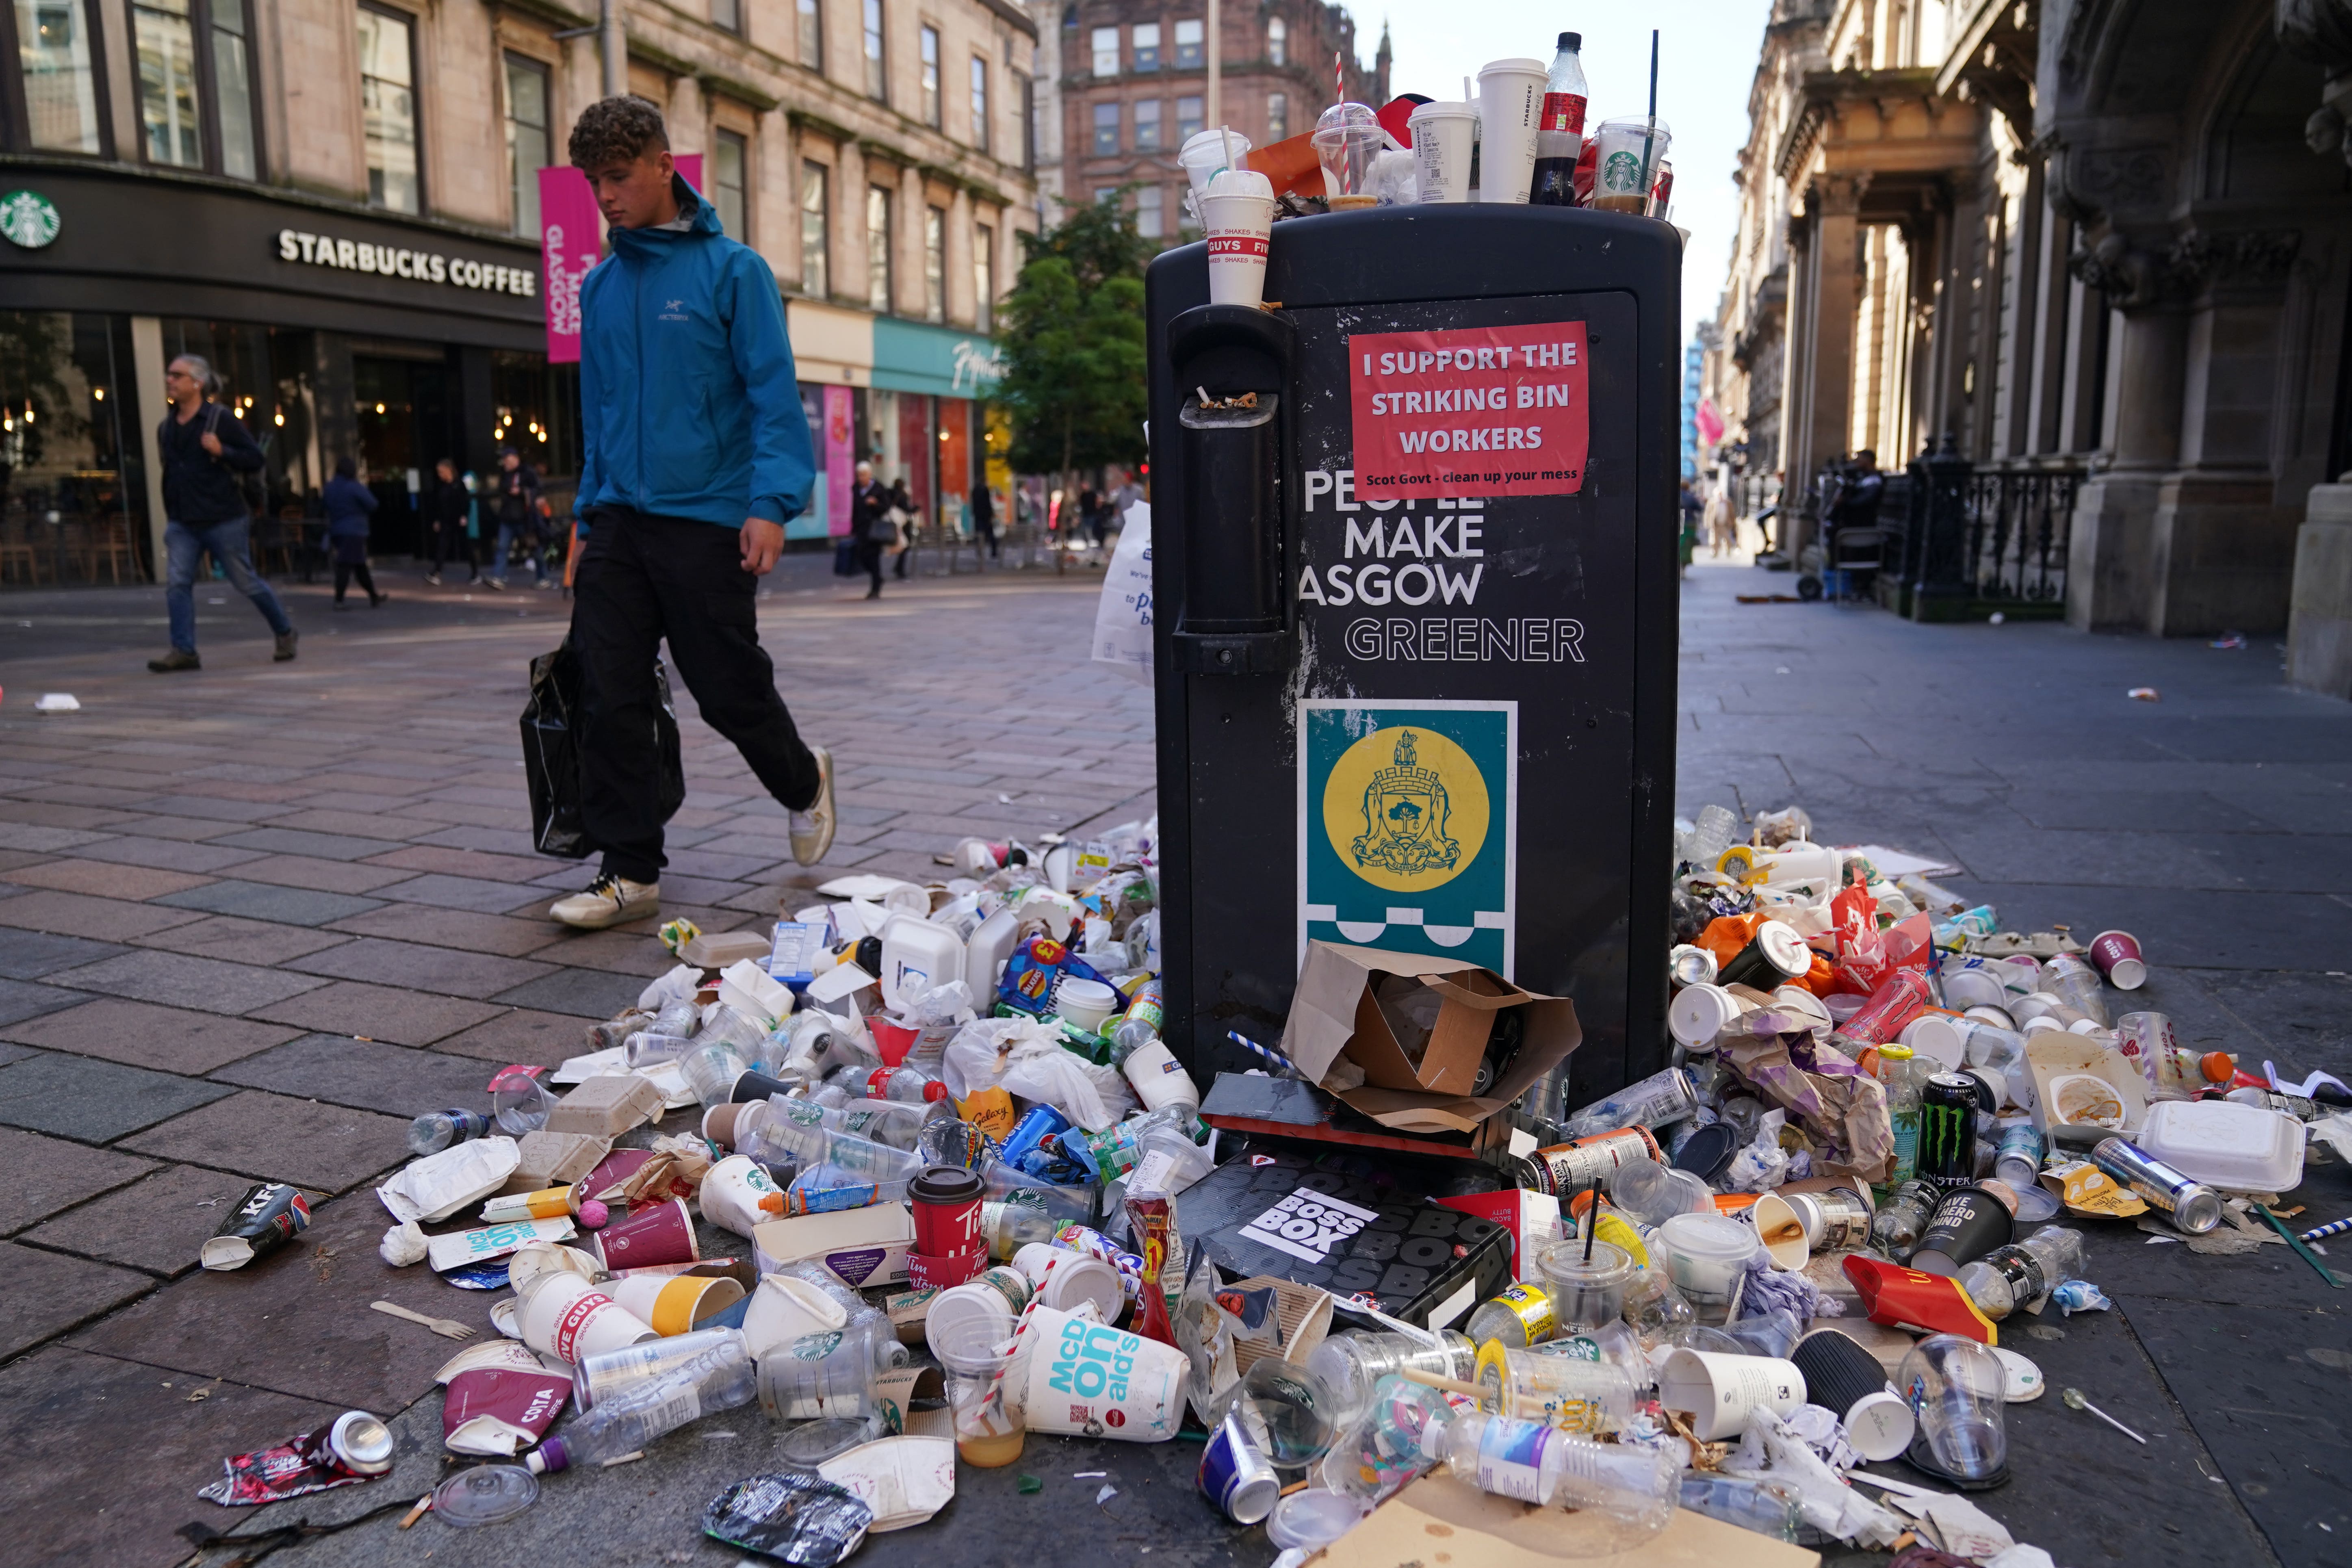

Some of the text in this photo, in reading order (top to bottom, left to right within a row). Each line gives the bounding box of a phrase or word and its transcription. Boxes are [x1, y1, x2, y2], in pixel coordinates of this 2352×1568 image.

[1524, 84, 1532, 126] STARBUCKS
[1209, 241, 1240, 252] GUYS
[279, 229, 448, 284] STARBUCKS
[449, 257, 537, 297] COFFEE
[546, 224, 567, 336] GLASGOW
[1364, 343, 1577, 376] I SUPPORT THE
[1372, 384, 1569, 416] STRIKING BIN
[1399, 426, 1542, 454] WORKERS
[1366, 475, 1396, 486] Scot
[1399, 473, 1431, 484] Govt
[1443, 471, 1479, 483] clean
[1484, 472, 1501, 484] up
[1505, 470, 1537, 485] your
[1541, 469, 1577, 480] mess
[1344, 515, 1484, 559] MAKE
[1126, 594, 1135, 603] to
[1298, 563, 1484, 606] ASGOW
[1344, 617, 1585, 662] GREENER
[2104, 939, 2120, 959] COSTA
[1020, 969, 1043, 996] WALKERS
[2161, 1032, 2172, 1064] COFFEE
[2167, 1022, 2183, 1079] COSTA
[973, 1106, 1008, 1127] Galaxy
[1000, 1113, 1032, 1146] pepsi
[993, 1146, 1005, 1161] SALT
[1533, 1157, 1543, 1171] PEACH
[1551, 1160, 1567, 1197] DRAGON
[240, 1184, 285, 1216] KFC
[1938, 1197, 1971, 1210] EAVE
[1942, 1206, 1976, 1220] HERD
[2106, 1197, 2122, 1211] Light
[284, 1212, 294, 1225] pepsi
[1274, 1195, 1365, 1234] BOSS
[1927, 1218, 1962, 1232] EHIND
[466, 1232, 493, 1252] McD
[486, 1224, 518, 1247] on
[1251, 1208, 1349, 1254] BOX
[892, 1271, 909, 1279] EGGS
[906, 1255, 927, 1274] Tim
[554, 1300, 573, 1329] SHAKES
[568, 1295, 605, 1327] GUYS
[1527, 1319, 1544, 1331] AGAIN
[579, 1314, 597, 1340] SHAKES
[1561, 1323, 1594, 1333] NERO
[1049, 1320, 1087, 1394] McD
[1073, 1327, 1120, 1398] on
[1108, 1336, 1140, 1402] ald's
[521, 1388, 554, 1423] COSTA
[547, 1398, 564, 1418] COFFEE
